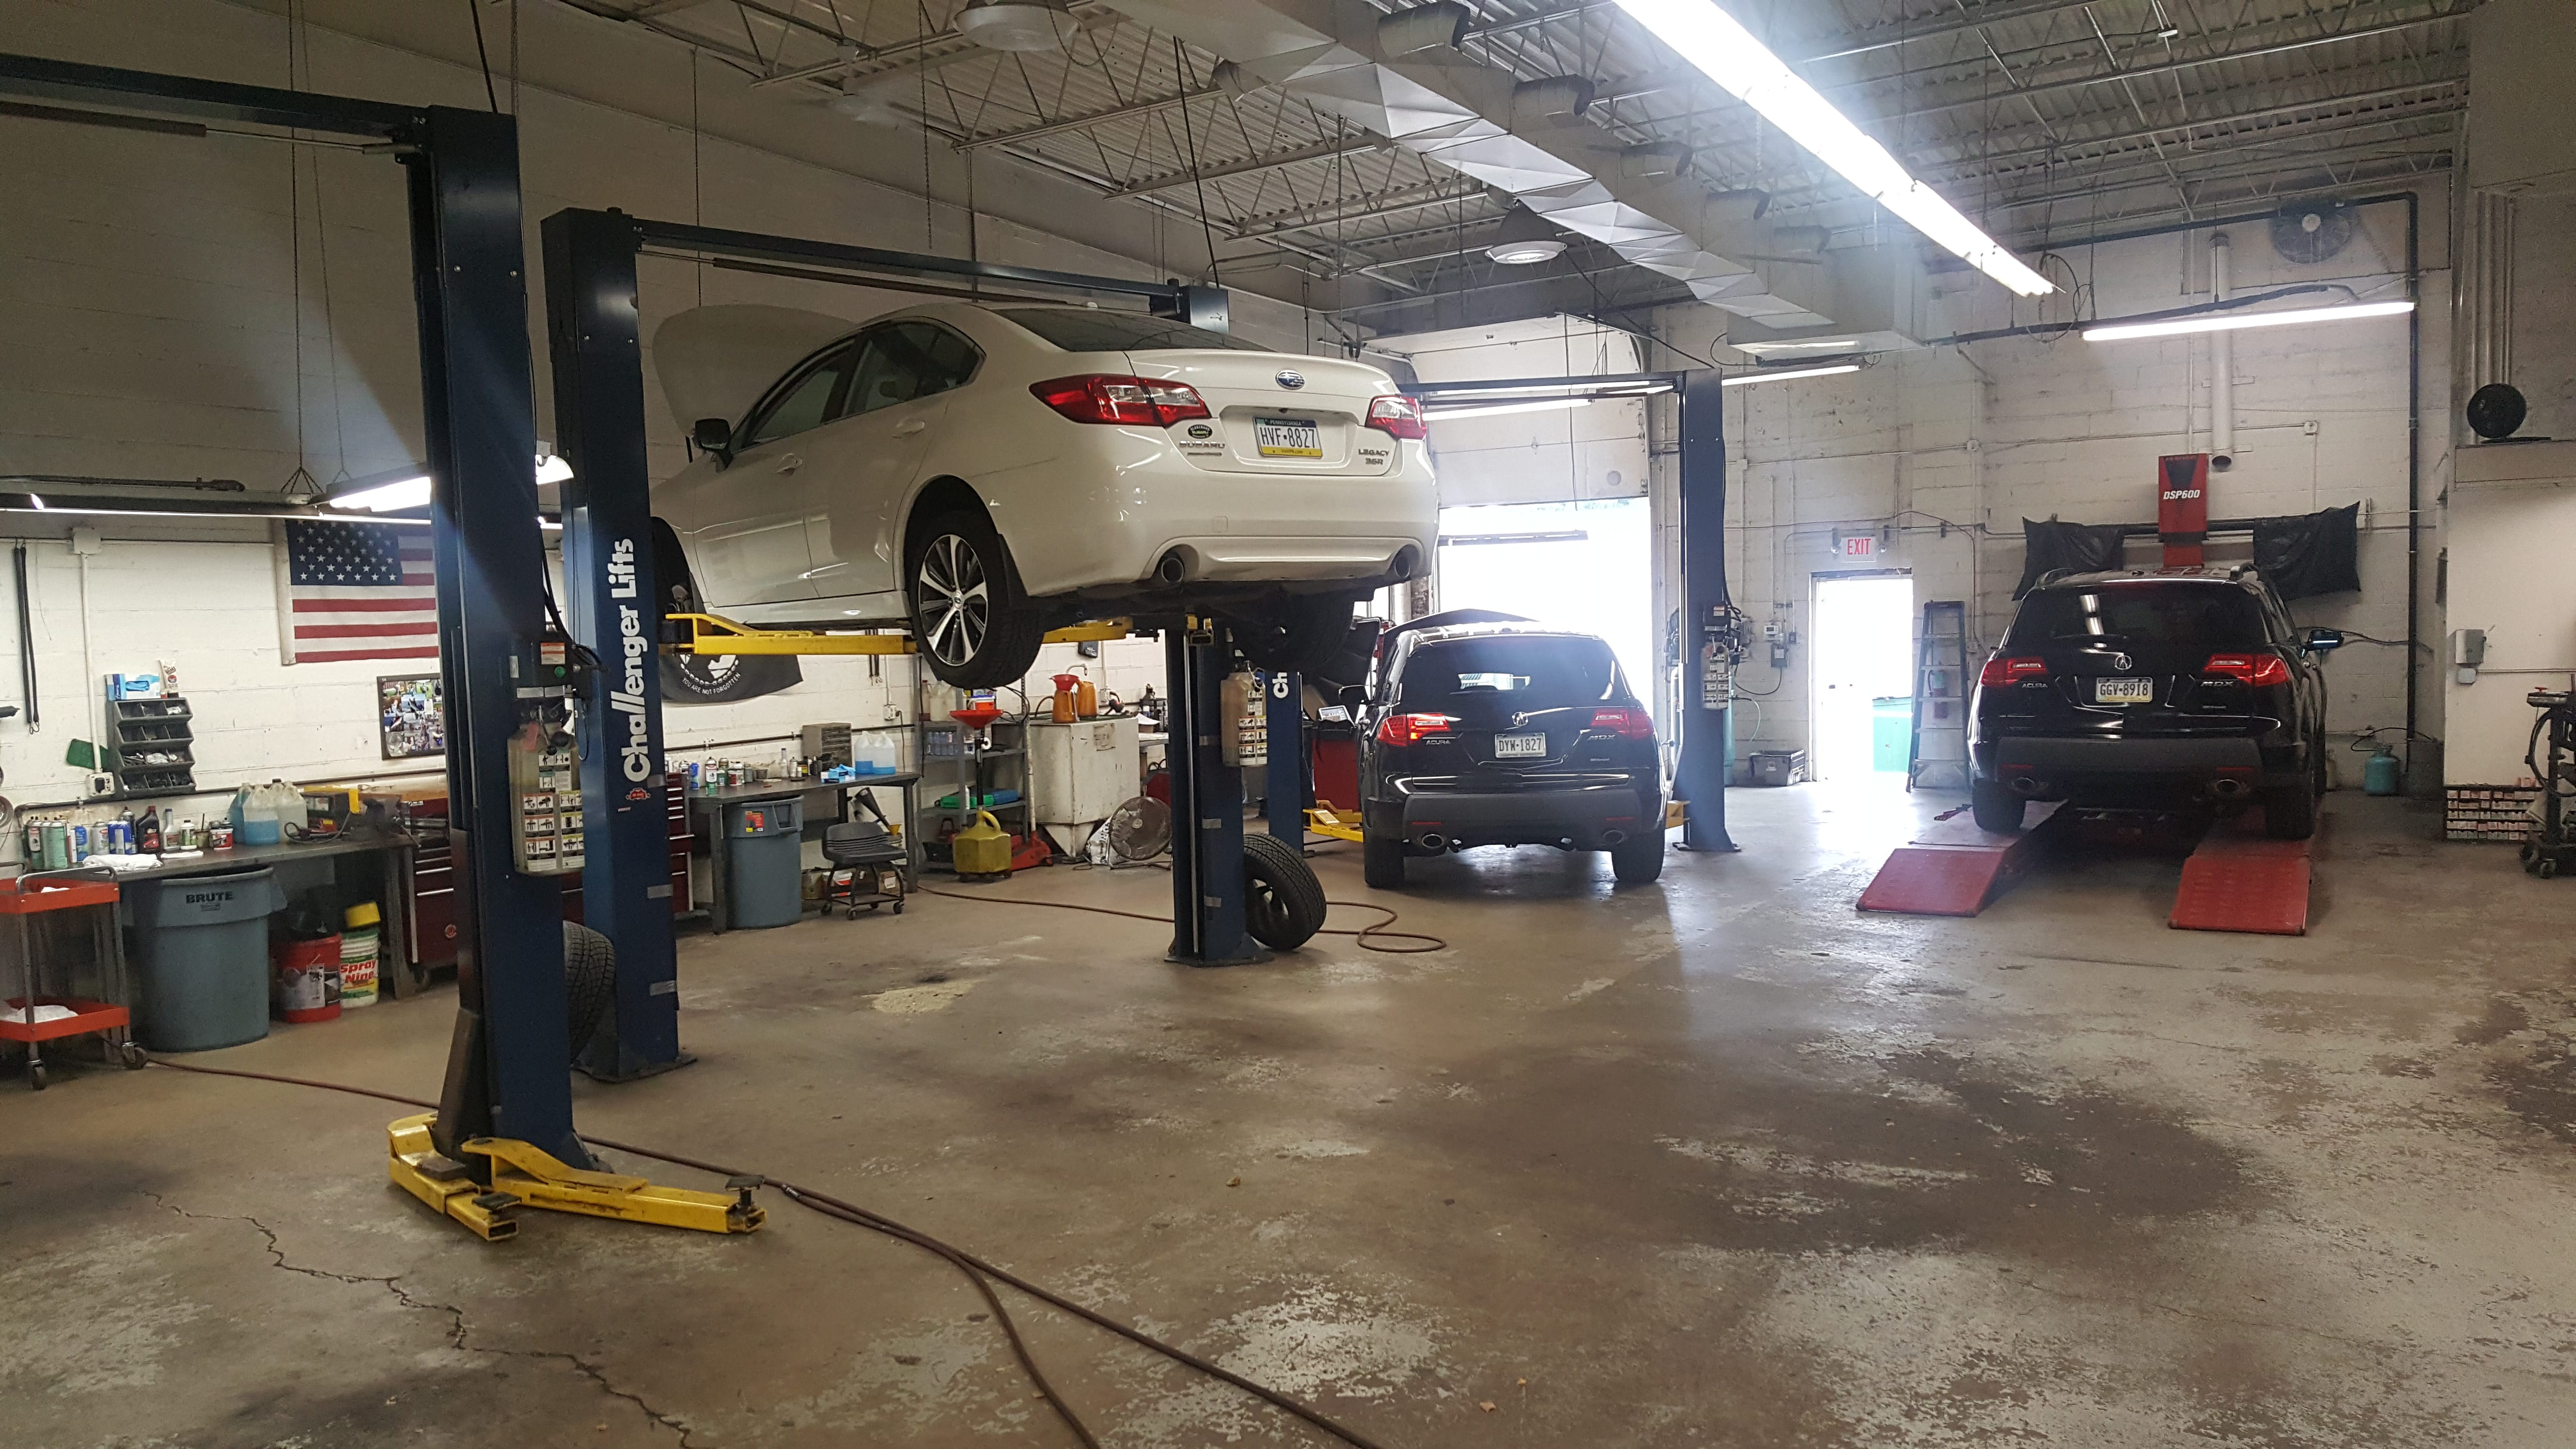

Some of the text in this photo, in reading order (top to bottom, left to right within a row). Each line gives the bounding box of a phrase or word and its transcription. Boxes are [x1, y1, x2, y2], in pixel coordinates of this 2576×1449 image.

[1358, 448, 1389, 457] LEGACY
[2163, 489, 2200, 500] DSP600
[1847, 538, 1871, 555] EXIT
[608, 538, 637, 598] Lifts
[682, 677, 692, 687] YOU
[691, 684, 702, 693] ARE
[713, 672, 741, 694] FORGOTTEN
[610, 605, 651, 782] Challenger
[186, 891, 234, 903] BRUTE
[340, 959, 376, 974] Spray
[345, 971, 374, 983] Nine
